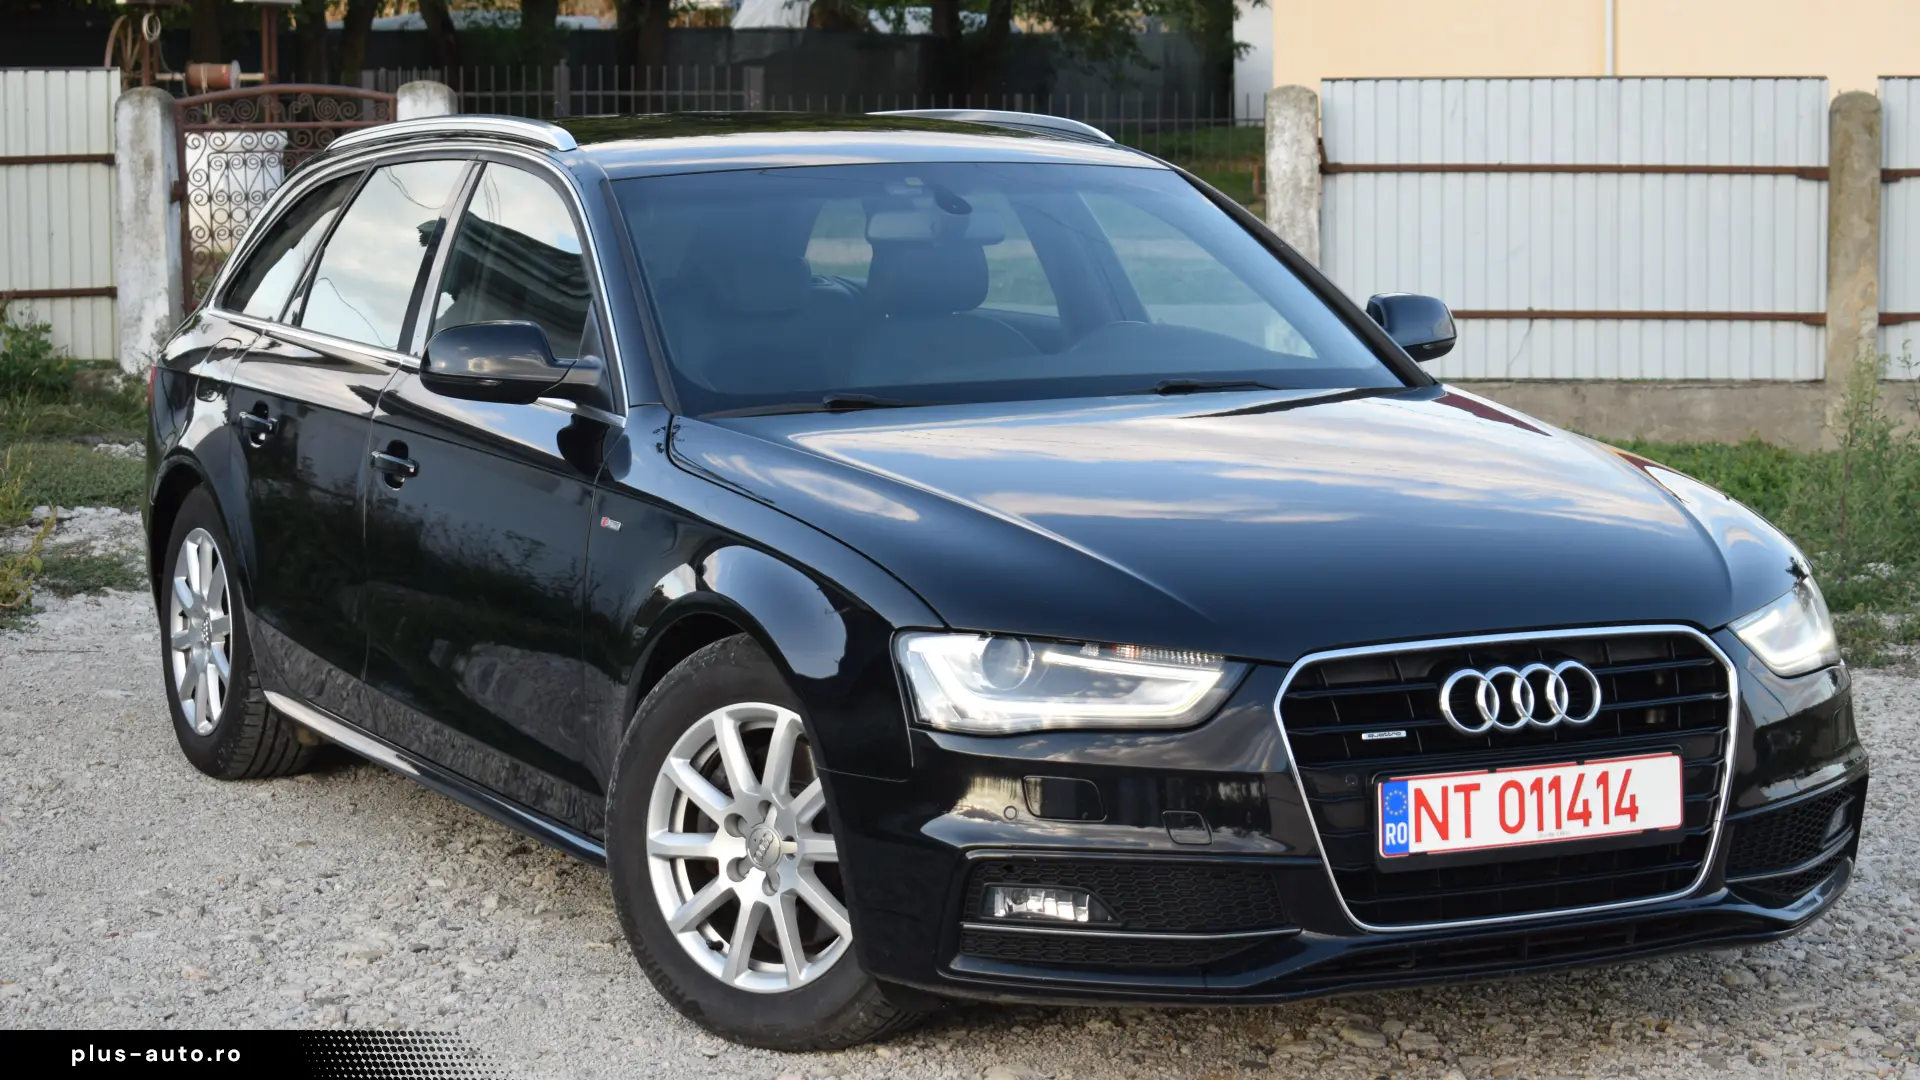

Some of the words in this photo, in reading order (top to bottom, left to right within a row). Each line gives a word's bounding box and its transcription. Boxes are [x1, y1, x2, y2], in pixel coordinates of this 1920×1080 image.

[1414, 782, 1480, 843] NT
[1499, 769, 1639, 834] 011414
[1385, 822, 1407, 845] RO
